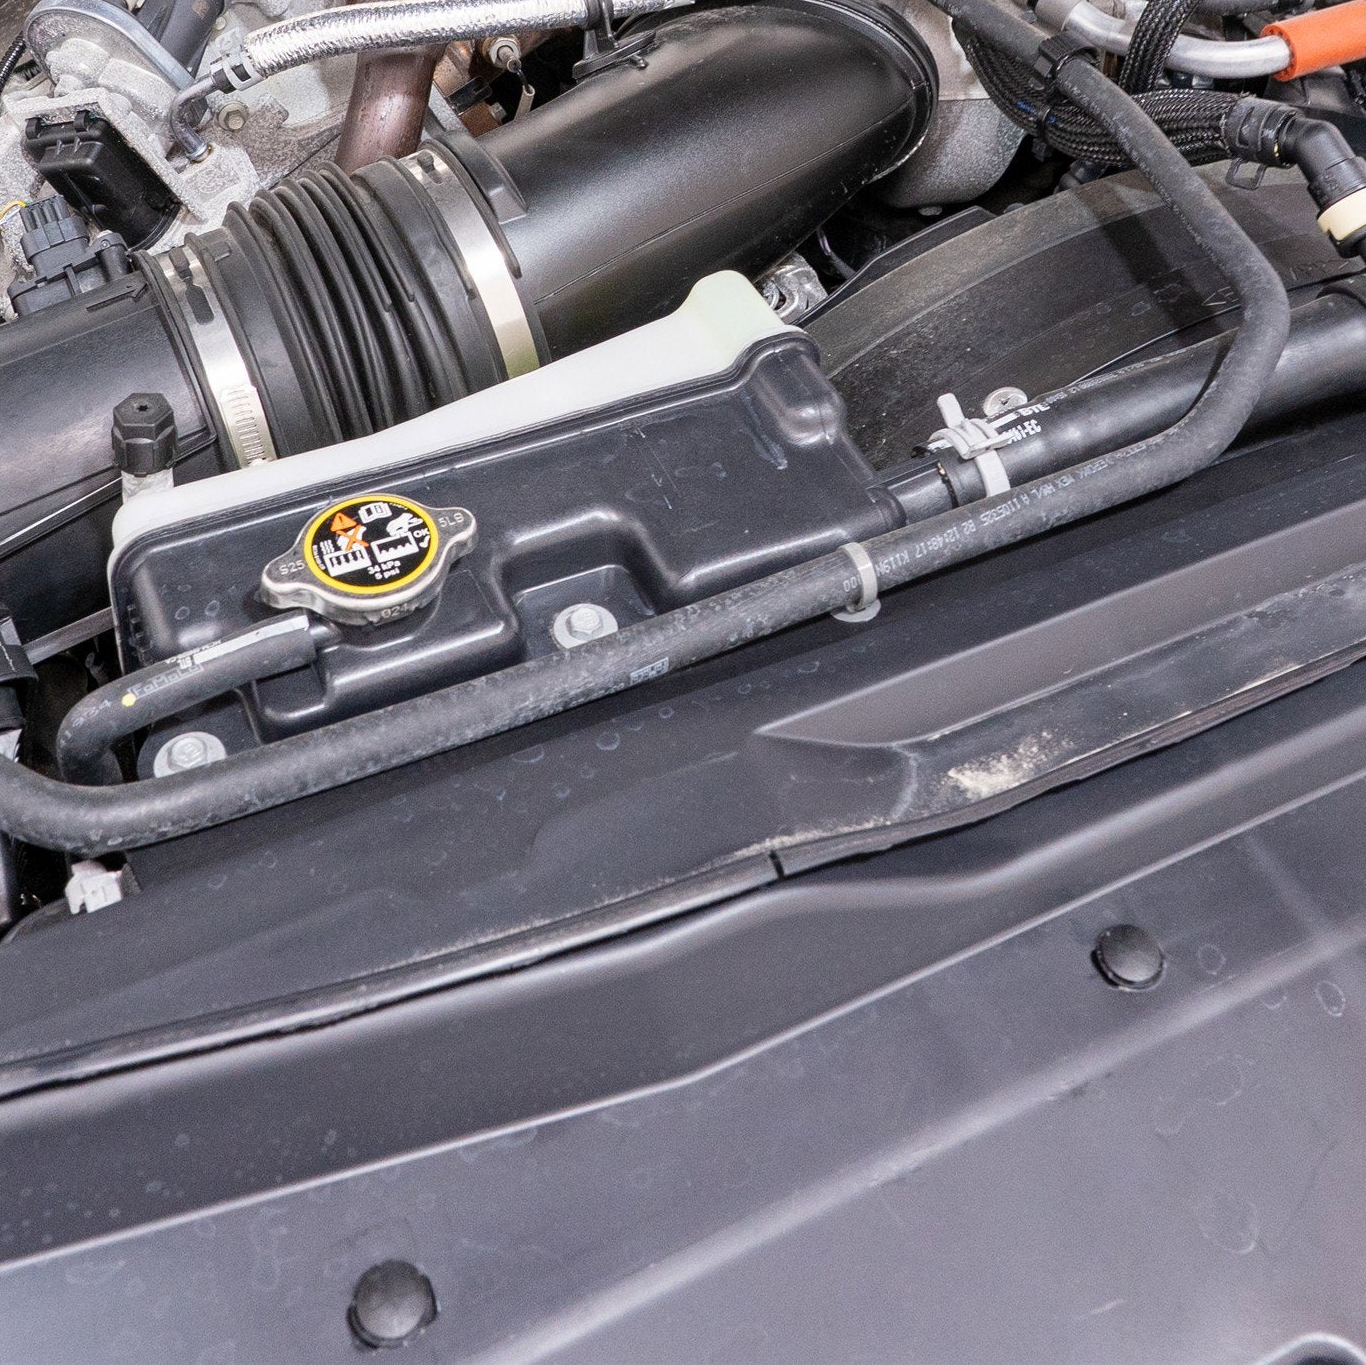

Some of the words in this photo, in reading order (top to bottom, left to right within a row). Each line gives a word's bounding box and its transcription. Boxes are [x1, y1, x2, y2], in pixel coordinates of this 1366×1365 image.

[412, 527, 430, 538] OK
[277, 559, 306, 575] S25
[366, 564, 381, 575] 34
[380, 559, 401, 571] kPa
[382, 567, 401, 580] psi
[133, 664, 200, 696] FoMoCo
